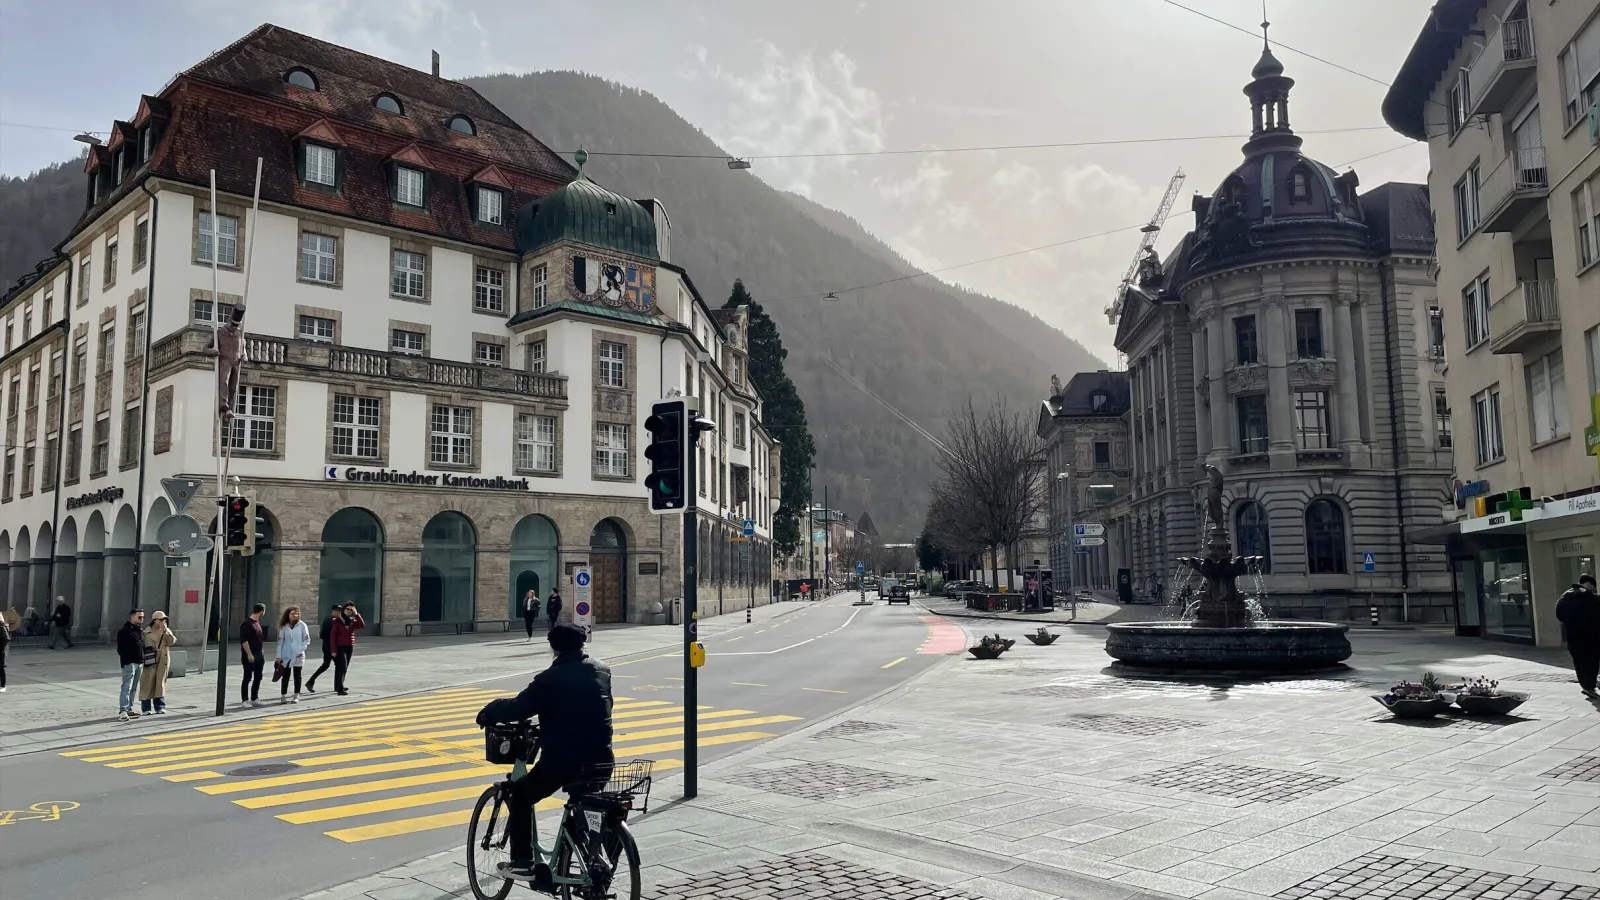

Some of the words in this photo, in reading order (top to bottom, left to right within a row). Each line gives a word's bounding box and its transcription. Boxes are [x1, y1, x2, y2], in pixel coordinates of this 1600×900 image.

[345, 467, 439, 486] Graubündner
[442, 473, 529, 491] Kantonalbank
[1576, 495, 1596, 511] Apotheke
